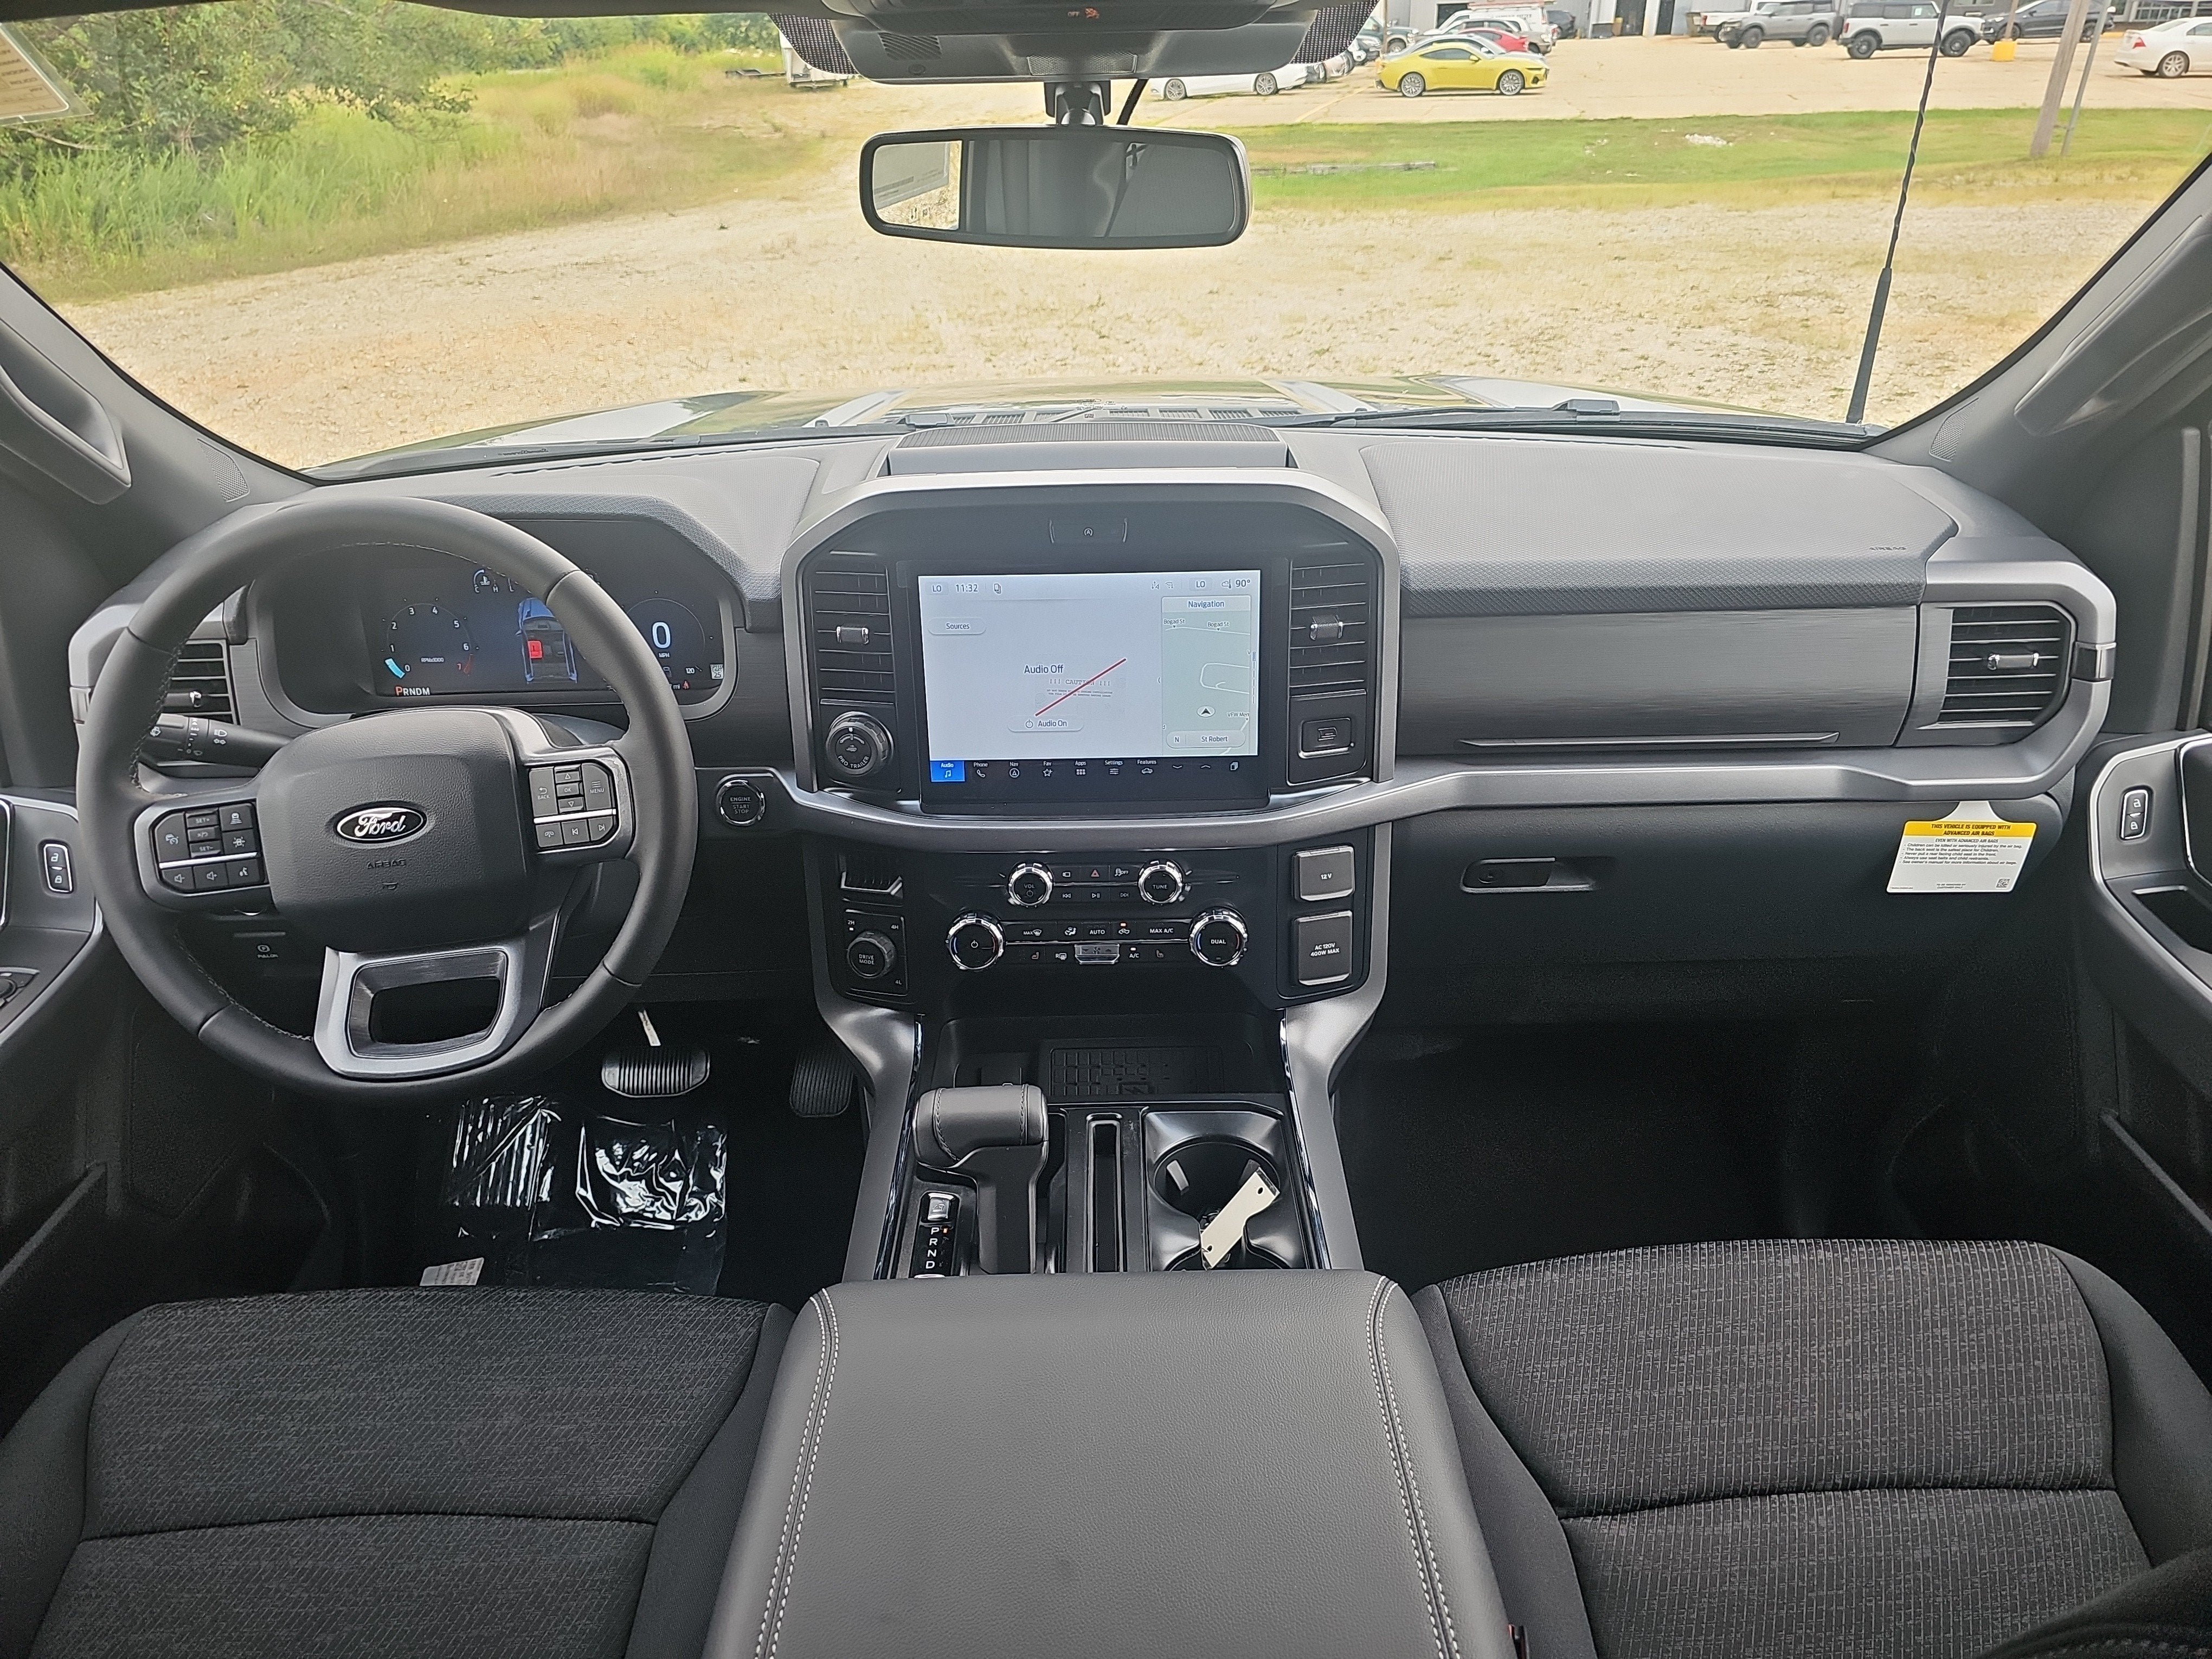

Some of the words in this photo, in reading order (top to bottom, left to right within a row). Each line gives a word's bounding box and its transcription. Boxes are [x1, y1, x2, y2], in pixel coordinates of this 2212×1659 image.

[955, 584, 979, 592] 11:32
[1188, 600, 1225, 608] Navigation
[652, 621, 671, 649] 0
[1024, 665, 1049, 673] Audio
[1050, 664, 1064, 673] Off
[838, 755, 848, 766] PRO
[850, 756, 870, 769] TRAILER
[354, 813, 406, 837] Ford
[366, 858, 406, 870] AIRBAG
[930, 1227, 940, 1235] P
[929, 1238, 938, 1246] R
[927, 1249, 937, 1257] N
[925, 1261, 935, 1269] D
